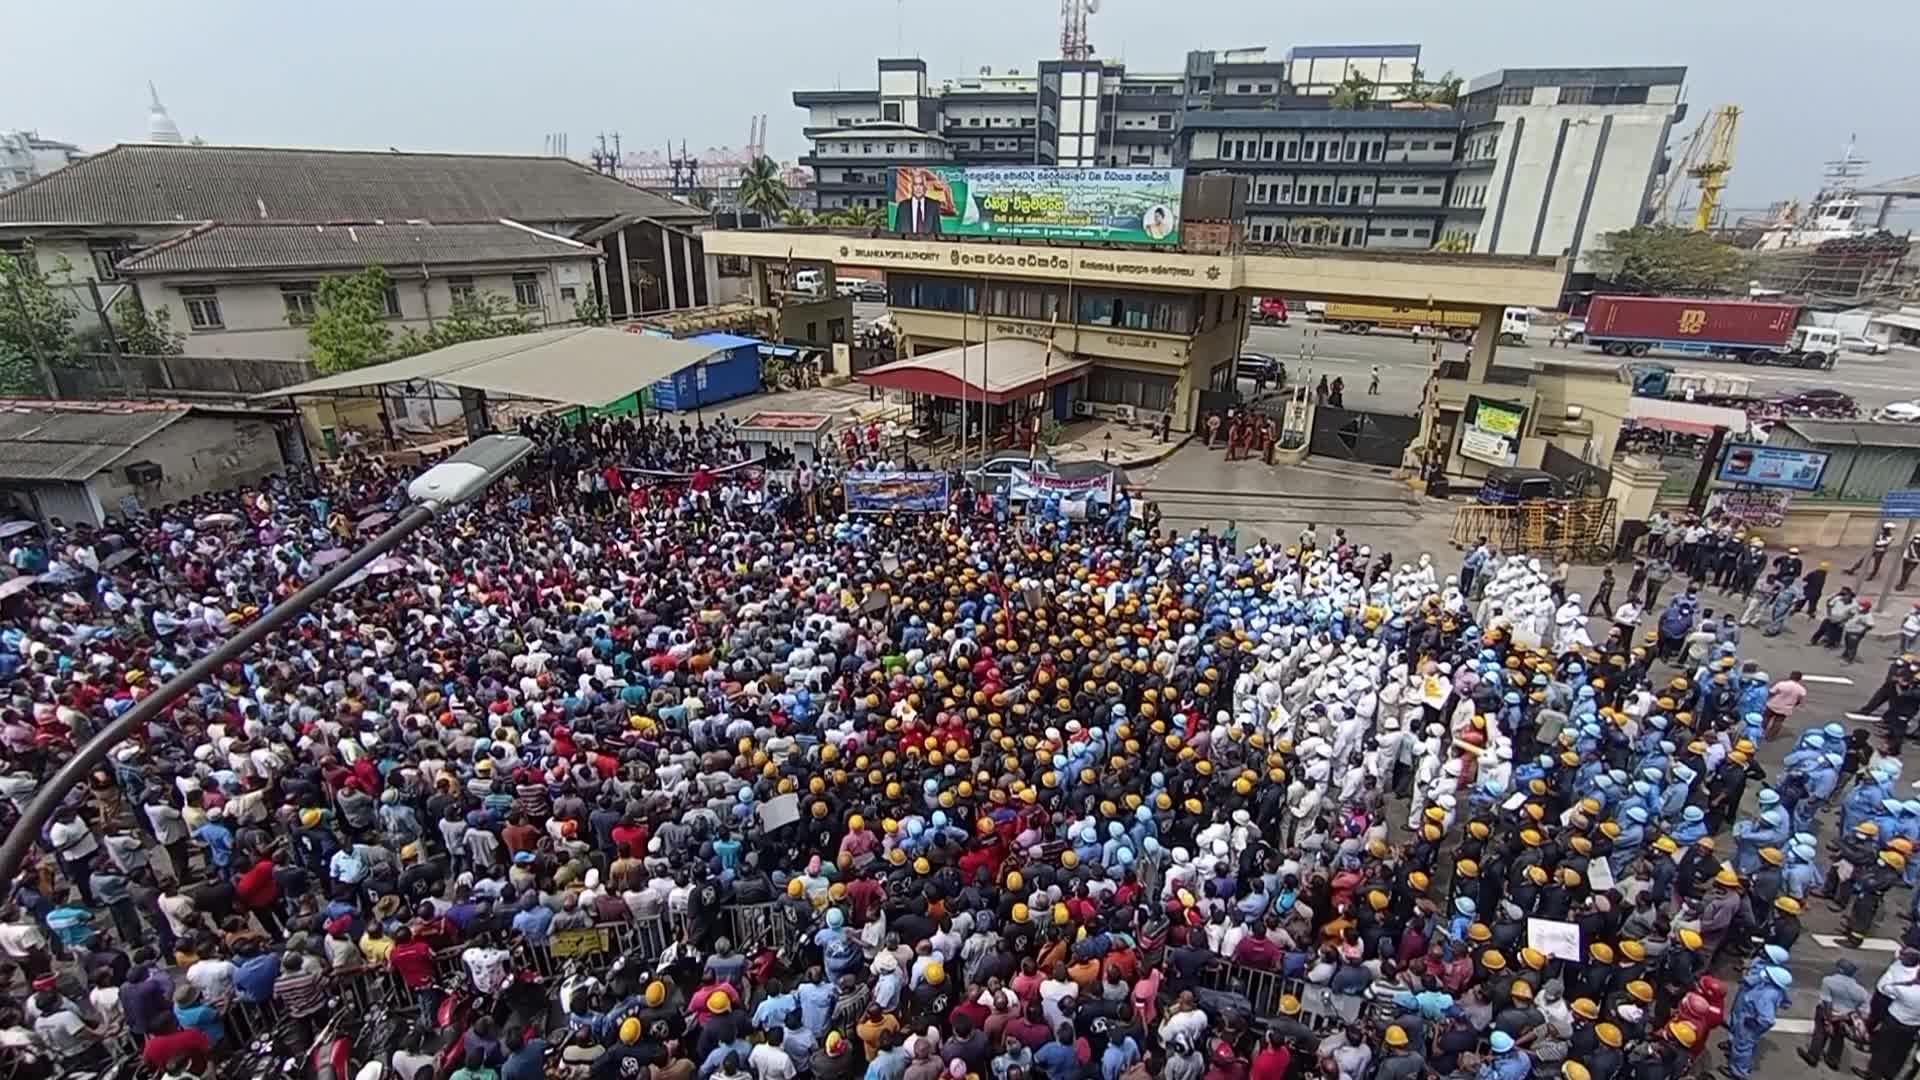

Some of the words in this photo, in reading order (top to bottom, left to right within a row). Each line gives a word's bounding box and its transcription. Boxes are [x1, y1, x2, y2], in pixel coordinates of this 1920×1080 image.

[905, 250, 940, 261] AUTHORITY
[961, 253, 985, 265] ලංකා
[988, 253, 1015, 266] වරාය
[1017, 254, 1069, 269] අධිකාරිය
